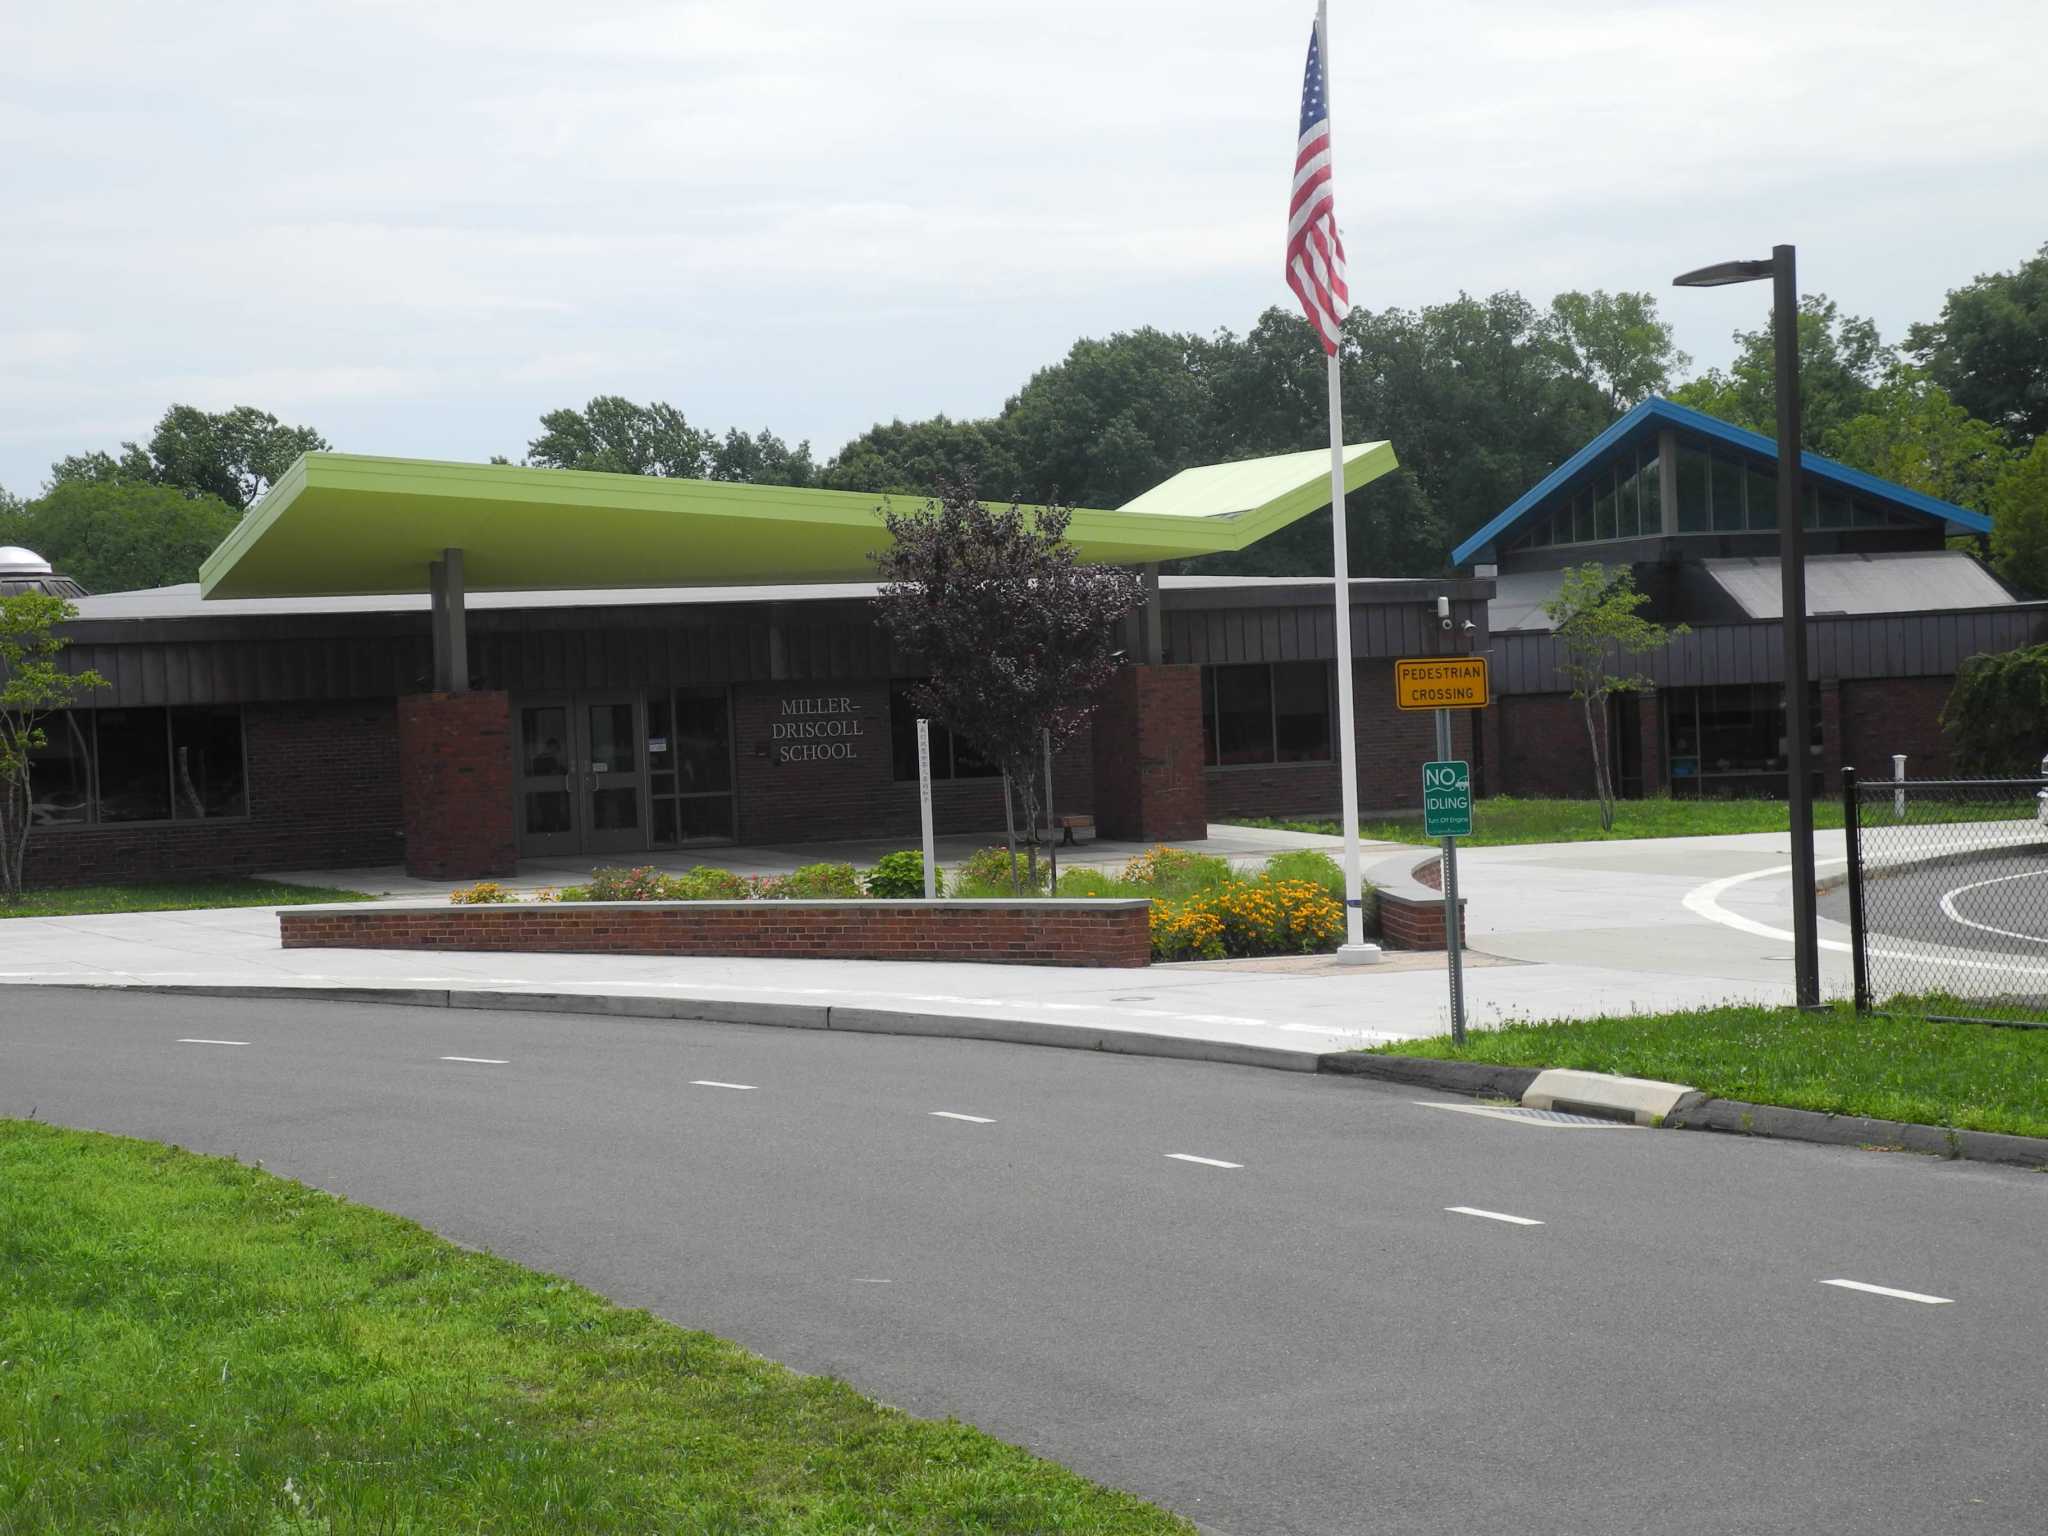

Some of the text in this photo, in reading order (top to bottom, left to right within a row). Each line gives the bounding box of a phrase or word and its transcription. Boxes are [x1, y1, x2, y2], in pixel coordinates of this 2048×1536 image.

[1402, 666, 1482, 681] PEDESTRIAN
[1411, 687, 1474, 701] CROSSING
[771, 719, 864, 740] DRISCOLL
[780, 742, 857, 762] SCHOOL
[1426, 768, 1456, 787] NO
[1427, 797, 1468, 810] IDLING
